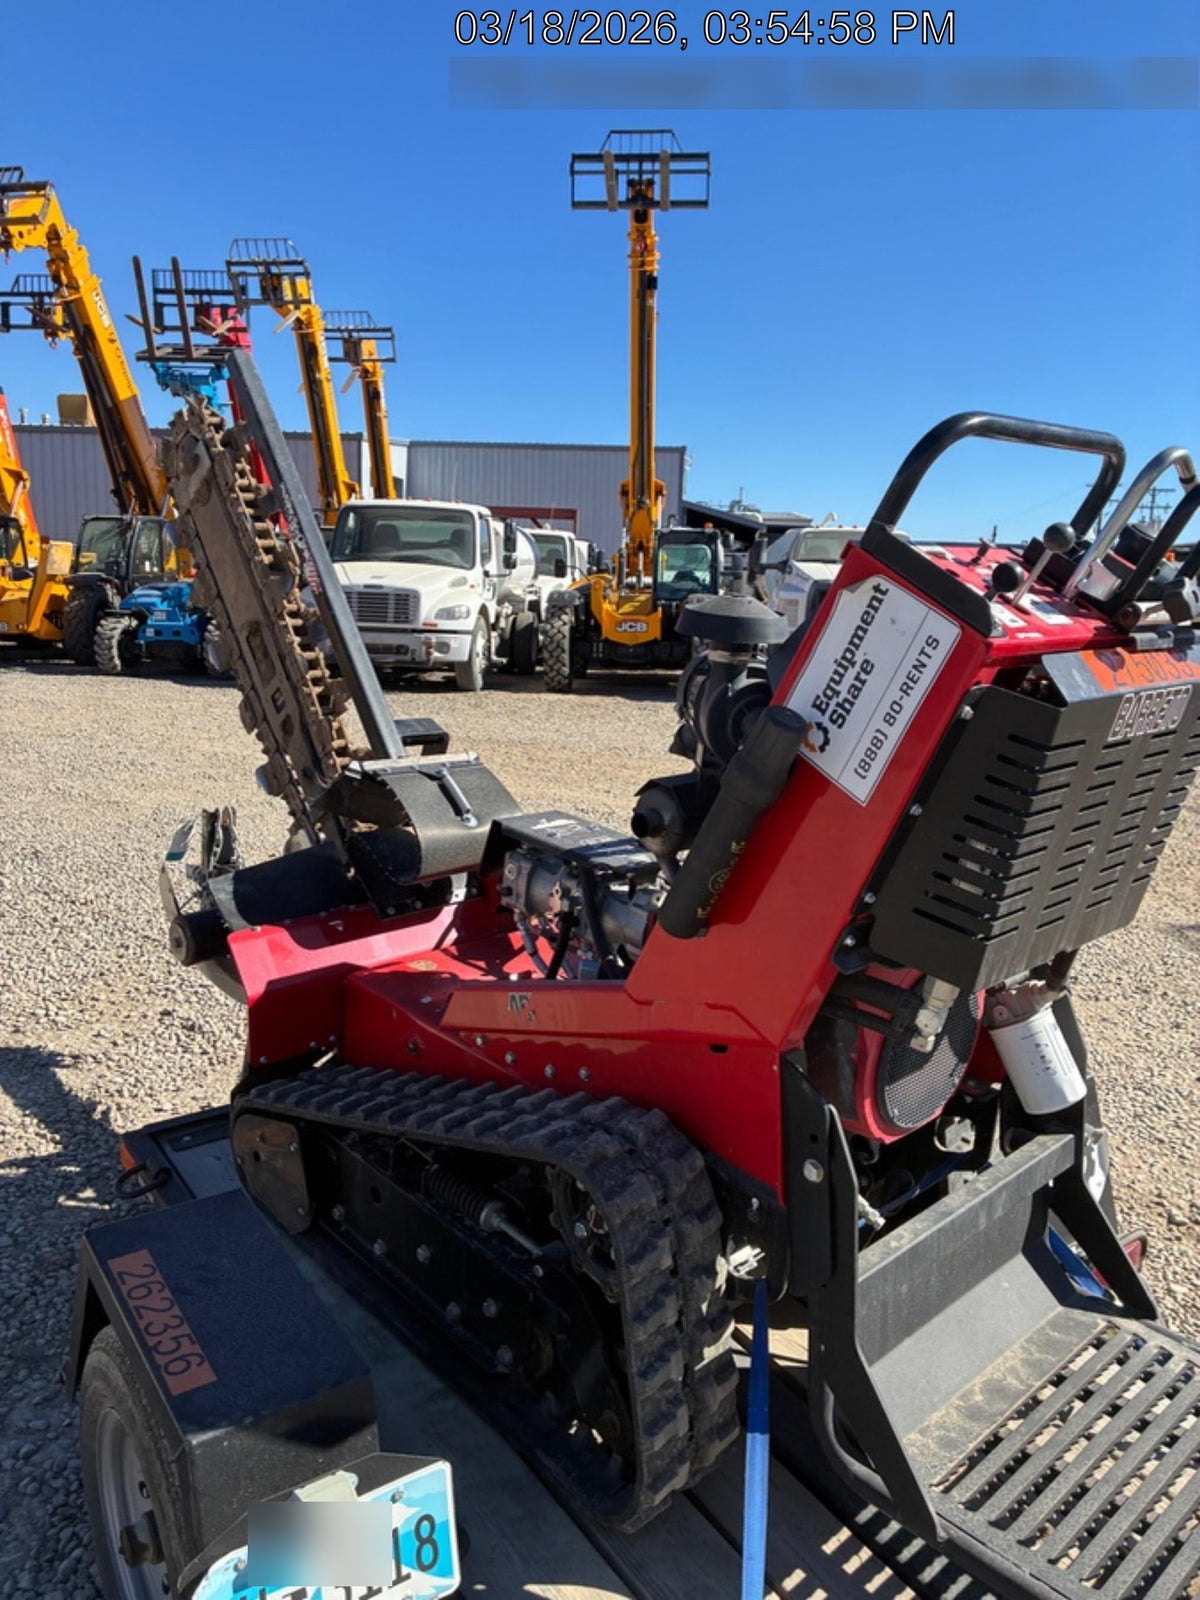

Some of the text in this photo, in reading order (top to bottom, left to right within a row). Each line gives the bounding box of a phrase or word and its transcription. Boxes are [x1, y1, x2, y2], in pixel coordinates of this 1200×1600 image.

[615, 621, 648, 632] JCB
[811, 582, 889, 716] Equipment
[828, 658, 875, 730] Share
[854, 634, 940, 780] (888) 80-RENTS
[117, 1263, 204, 1376] 262356
